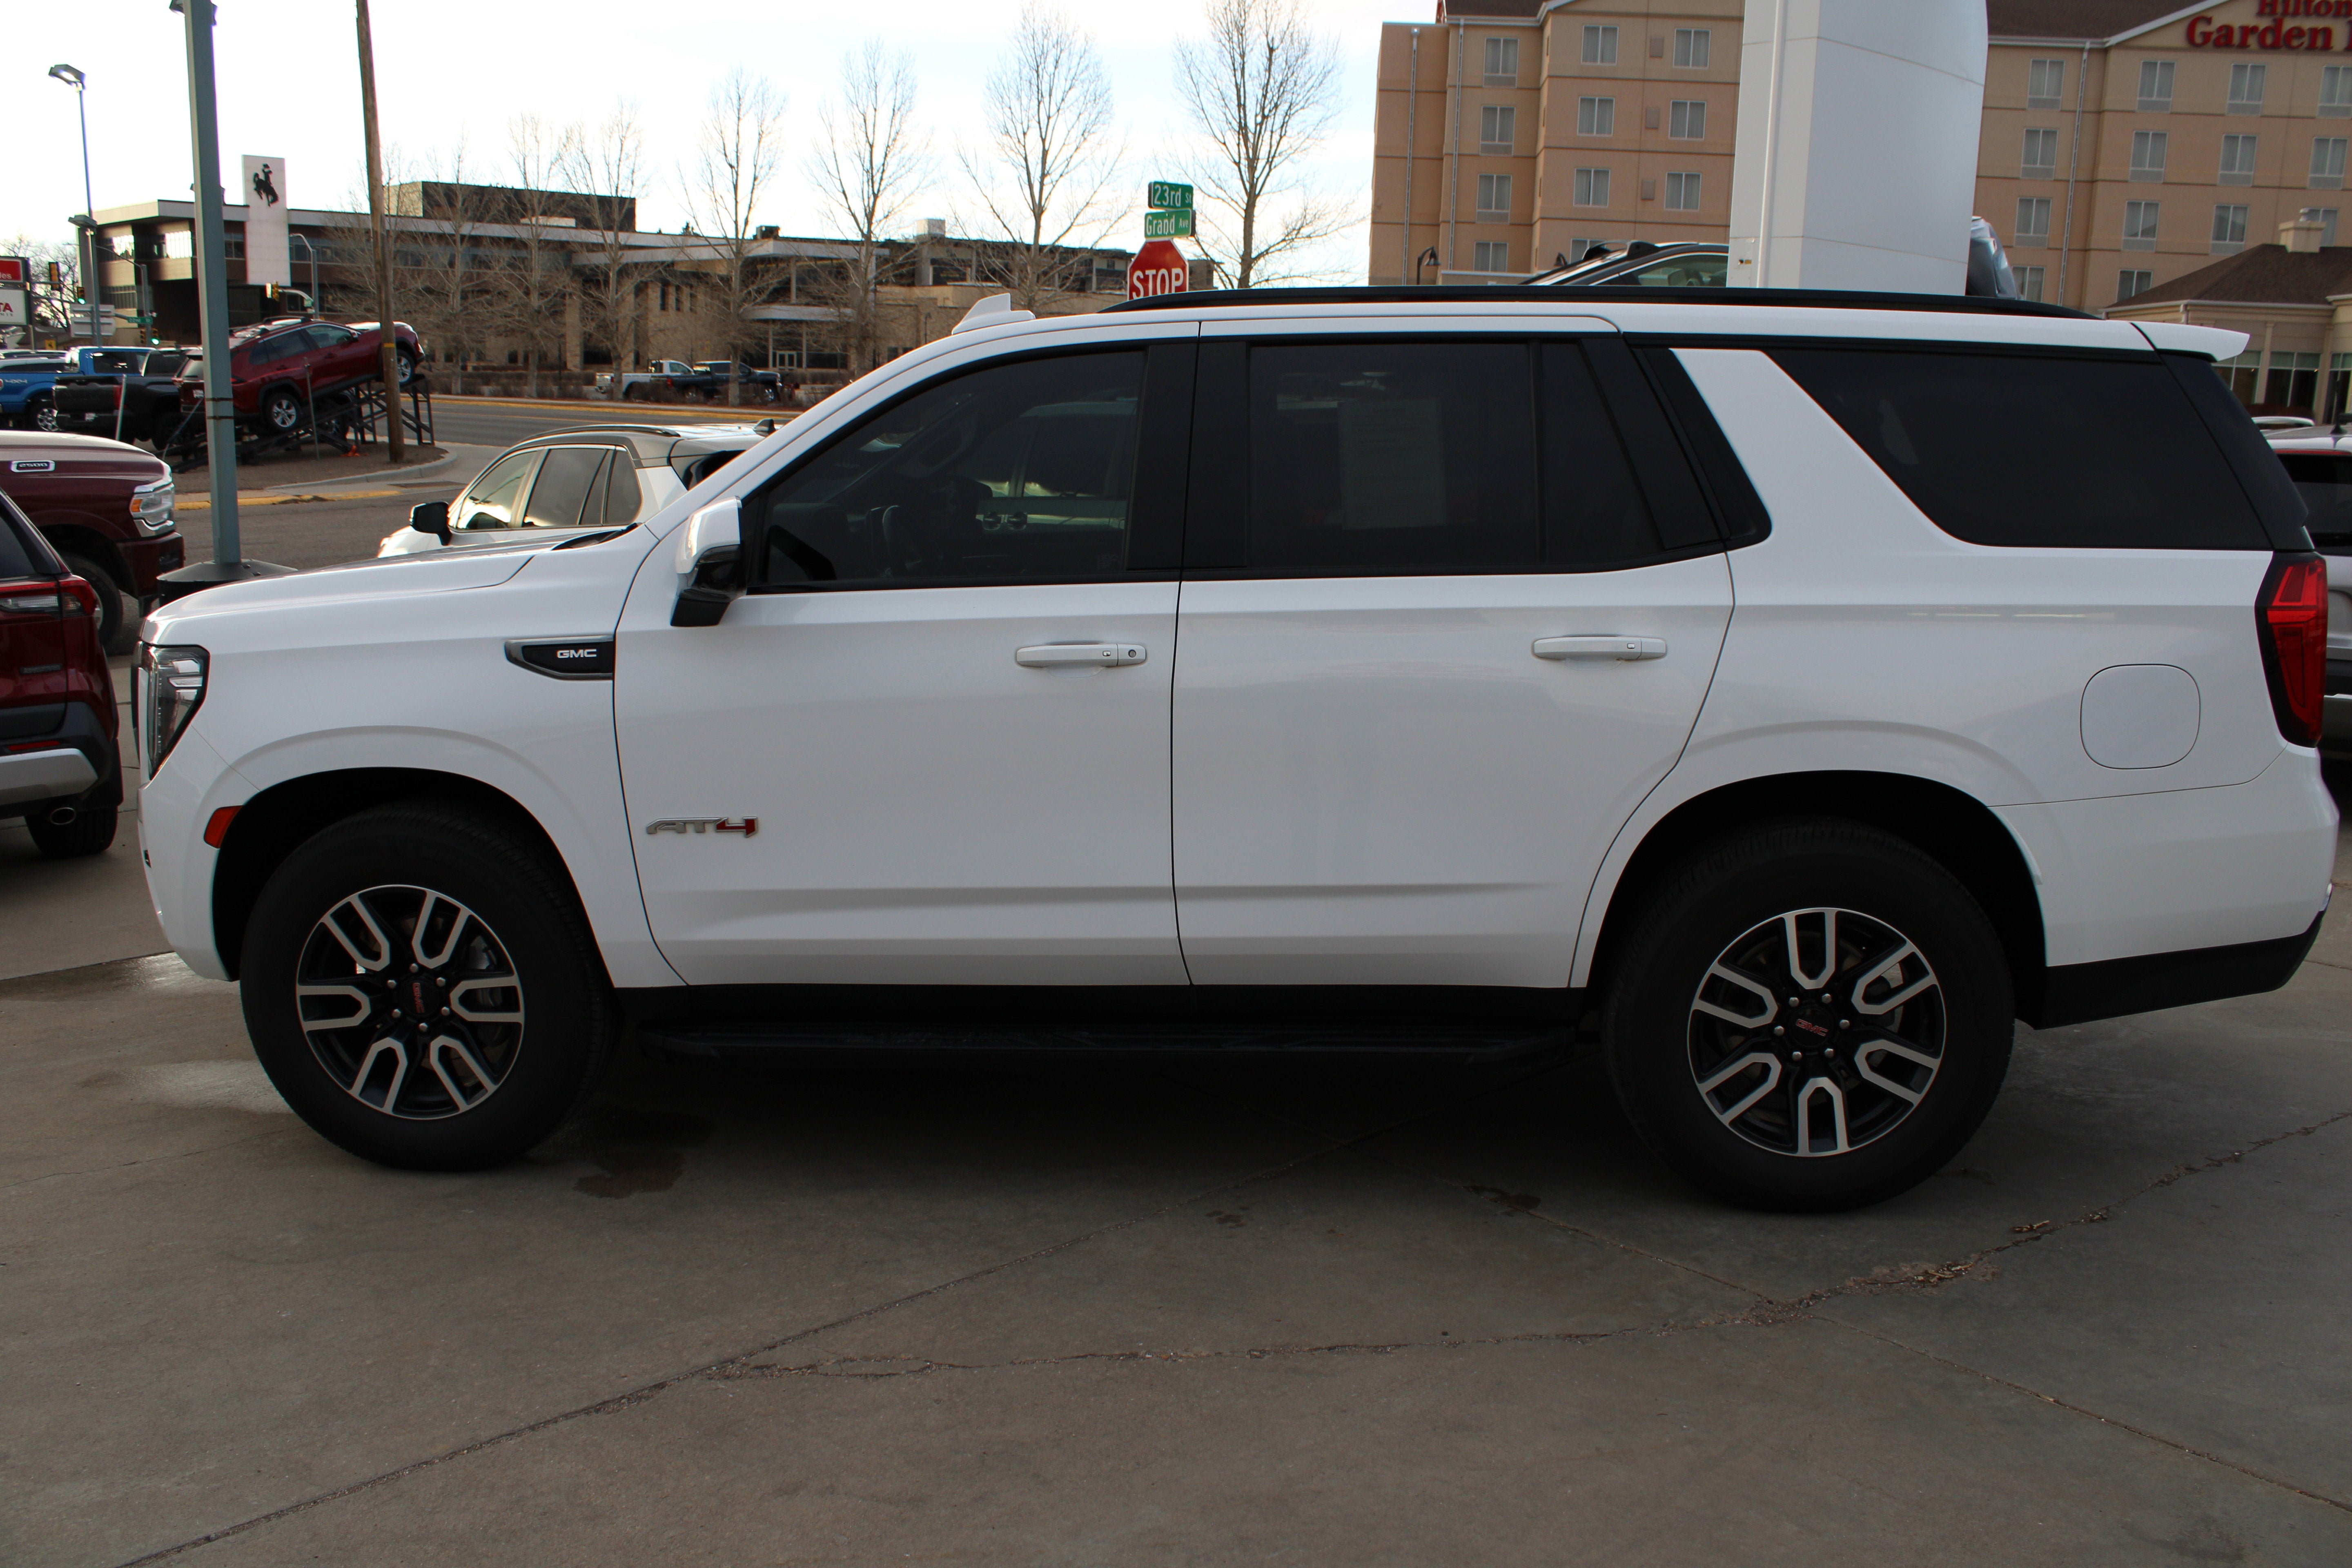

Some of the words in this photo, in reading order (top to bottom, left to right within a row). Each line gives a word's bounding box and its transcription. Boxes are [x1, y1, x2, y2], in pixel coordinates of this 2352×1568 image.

[2256, 0, 2352, 16] Hilton
[2187, 16, 2333, 50] Garden
[1154, 184, 1181, 207] 23rd
[1185, 192, 1192, 204] St
[1146, 214, 1175, 236] Grand
[1179, 218, 1189, 229] Ave
[1132, 267, 1184, 300] STOP
[557, 648, 597, 659] GMC
[646, 816, 759, 838] AT4
[412, 982, 425, 1013] GMC
[1795, 1018, 1829, 1036] GMC
